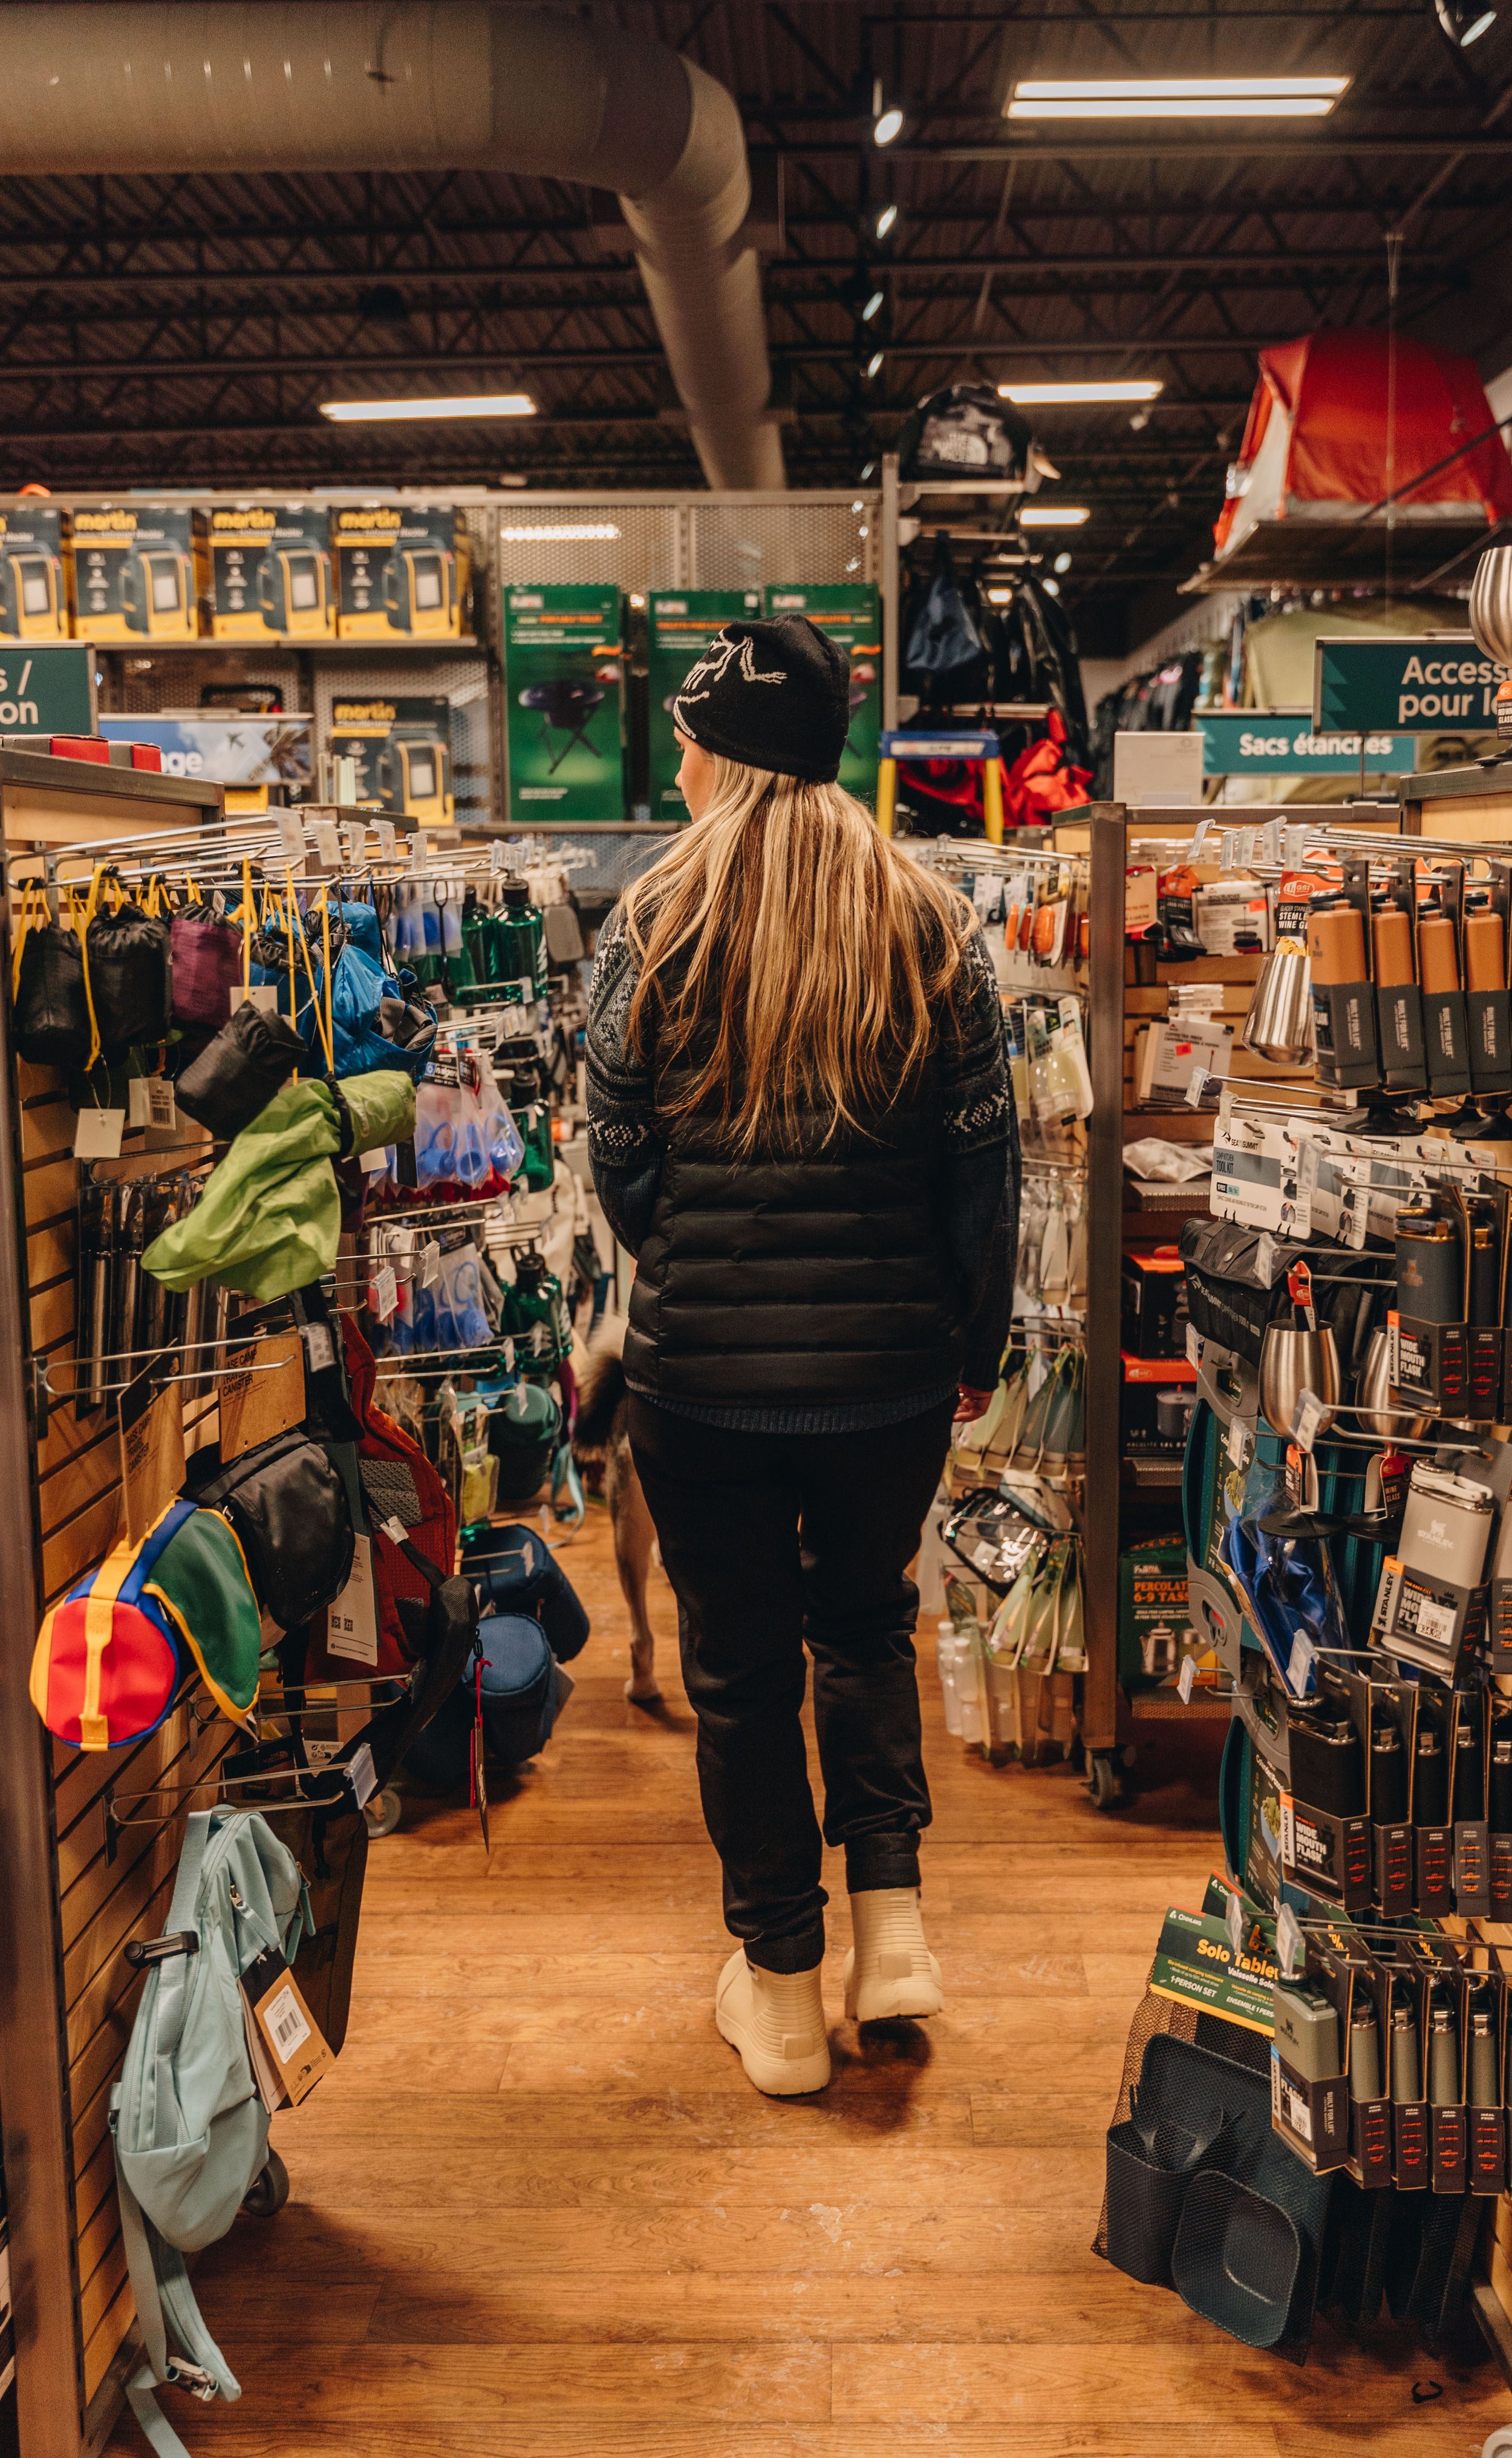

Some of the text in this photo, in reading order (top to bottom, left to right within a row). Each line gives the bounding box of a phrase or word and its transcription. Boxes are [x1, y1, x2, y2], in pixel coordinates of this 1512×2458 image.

[74, 509, 137, 531] martin
[213, 508, 276, 529] martin
[338, 508, 401, 529] martin
[1401, 655, 1512, 685] Access
[0, 701, 39, 725] on
[334, 700, 396, 721] martin
[1398, 695, 1475, 724] pour
[1239, 733, 1289, 756] Sacs
[1279, 912, 1308, 920] STEMLE
[1279, 920, 1297, 929] WINE
[435, 1065, 458, 1078] nalgen
[1216, 1160, 1227, 1173] TOOL
[1400, 1338, 1419, 1354] WIDE
[226, 1348, 257, 1370] ASE CAMP
[1400, 1348, 1426, 1368] MOUTH
[1400, 1360, 1422, 1378] FLASK
[222, 1374, 253, 1397] CANISTER
[1417, 1529, 1455, 1549] STANLEY
[1133, 1592, 1190, 1603] 6-9 TASS
[1380, 1573, 1394, 1617] STANLEY
[1398, 1610, 1419, 1625] FLA
[1295, 1821, 1318, 1840] WIDE
[1295, 1832, 1327, 1855] MOUTH
[1296, 1844, 1323, 1864] FLASK
[1196, 1938, 1279, 1981] Solo Table
[1170, 1975, 1217, 1998] 1-PERSON SET
[1228, 1966, 1275, 1989] Vaisselle Solo
[1226, 1996, 1257, 2012] ENSEMBLE
[1259, 2007, 1274, 2018] PERS
